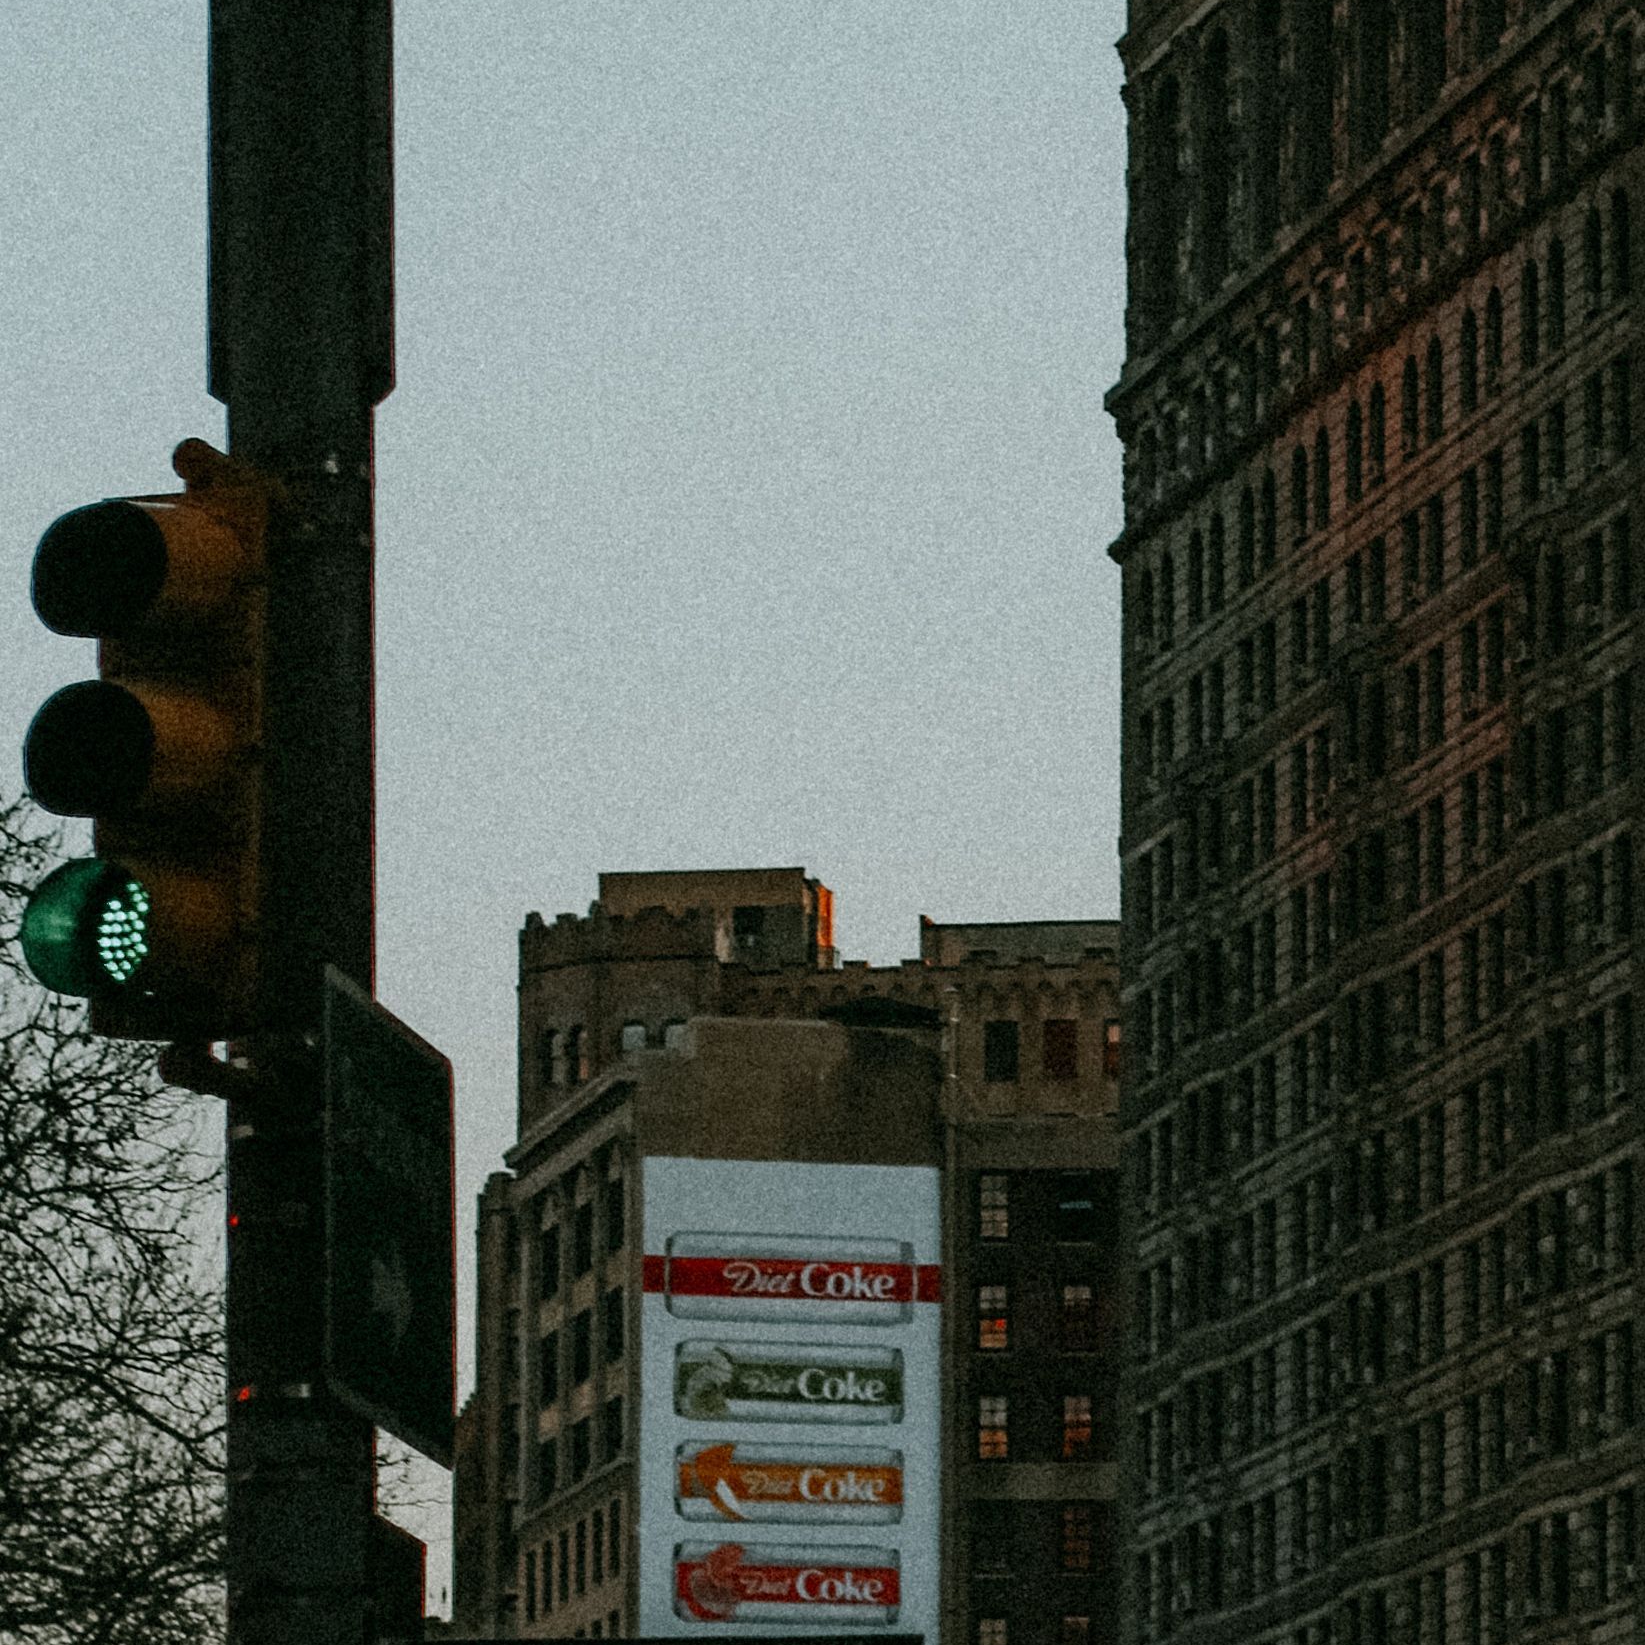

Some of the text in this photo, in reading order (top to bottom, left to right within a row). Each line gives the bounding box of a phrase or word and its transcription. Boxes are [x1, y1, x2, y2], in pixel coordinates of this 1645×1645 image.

[723, 1261, 895, 1300] Diet Coke
[743, 1368, 887, 1402] Diet Coke
[743, 1468, 886, 1502] Diet Coke
[795, 1568, 885, 1603] Coke
